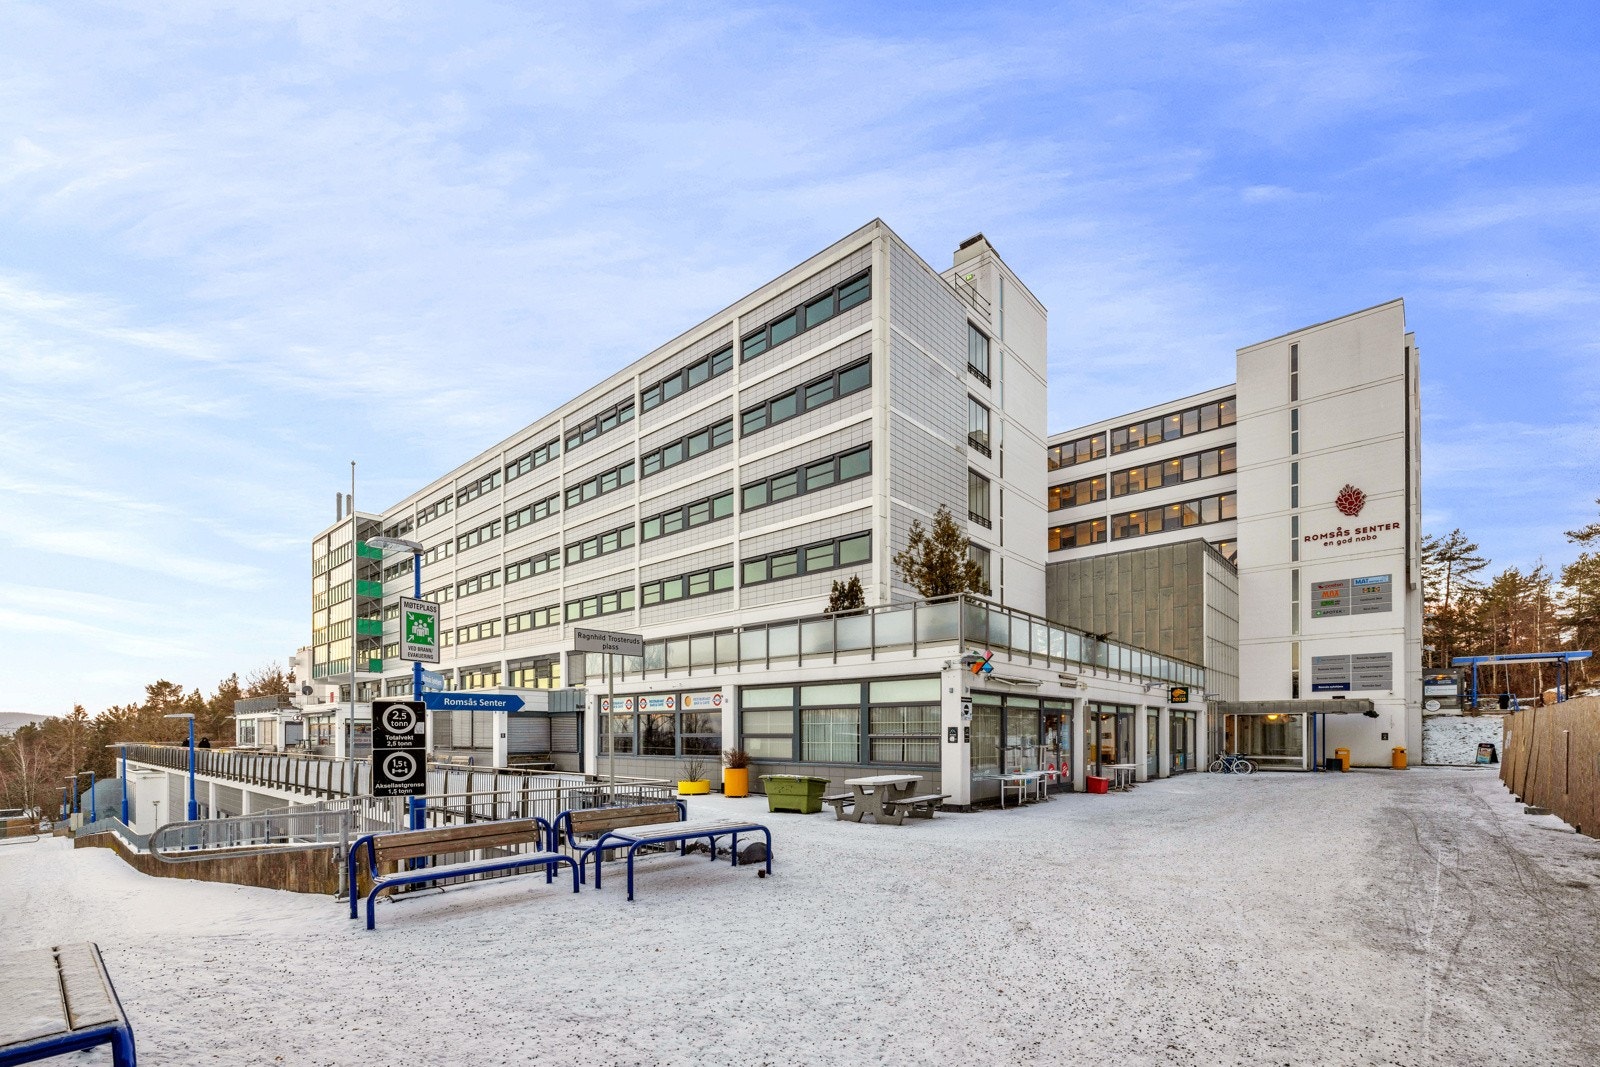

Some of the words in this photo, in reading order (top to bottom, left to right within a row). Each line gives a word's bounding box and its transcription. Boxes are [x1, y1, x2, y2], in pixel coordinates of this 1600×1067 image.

[1304, 526, 1350, 542] ROMSÅS
[1355, 522, 1400, 535] SENTER
[1336, 537, 1352, 546] god
[1355, 534, 1378, 542] nabo
[403, 601, 437, 613] MØTEPLASS
[577, 631, 606, 642] Ragnhild
[607, 635, 640, 645] Trosteruds
[407, 652, 434, 660] EVAKUERING
[443, 697, 477, 706] Romsås
[479, 698, 507, 707] Senter
[392, 710, 407, 720] 2,5
[392, 758, 403, 768] 1,5
[375, 782, 425, 790] Aksellastgrense
[388, 788, 397, 796] 1,5
